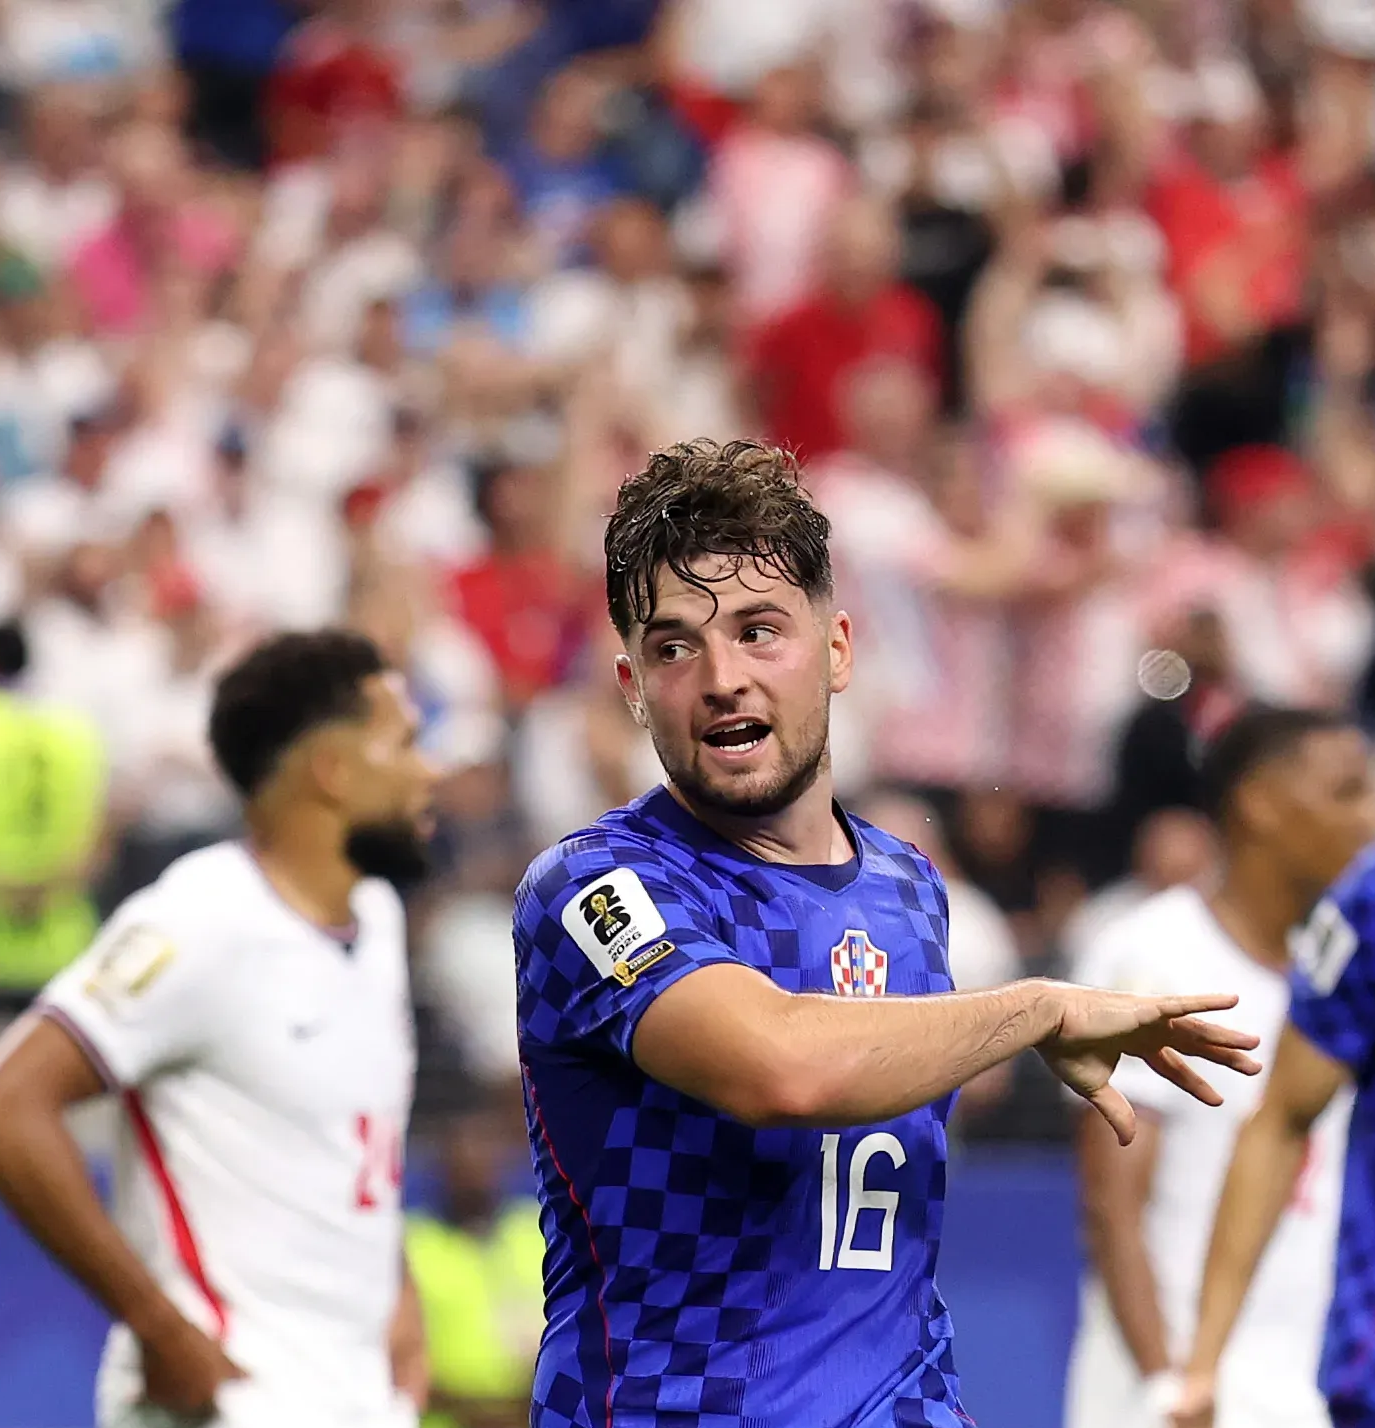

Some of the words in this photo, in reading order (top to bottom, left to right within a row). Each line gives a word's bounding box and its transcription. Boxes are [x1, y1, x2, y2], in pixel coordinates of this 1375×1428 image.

[605, 920, 624, 938] FIFA
[611, 931, 642, 961] 2026
[819, 1132, 907, 1271] 16
